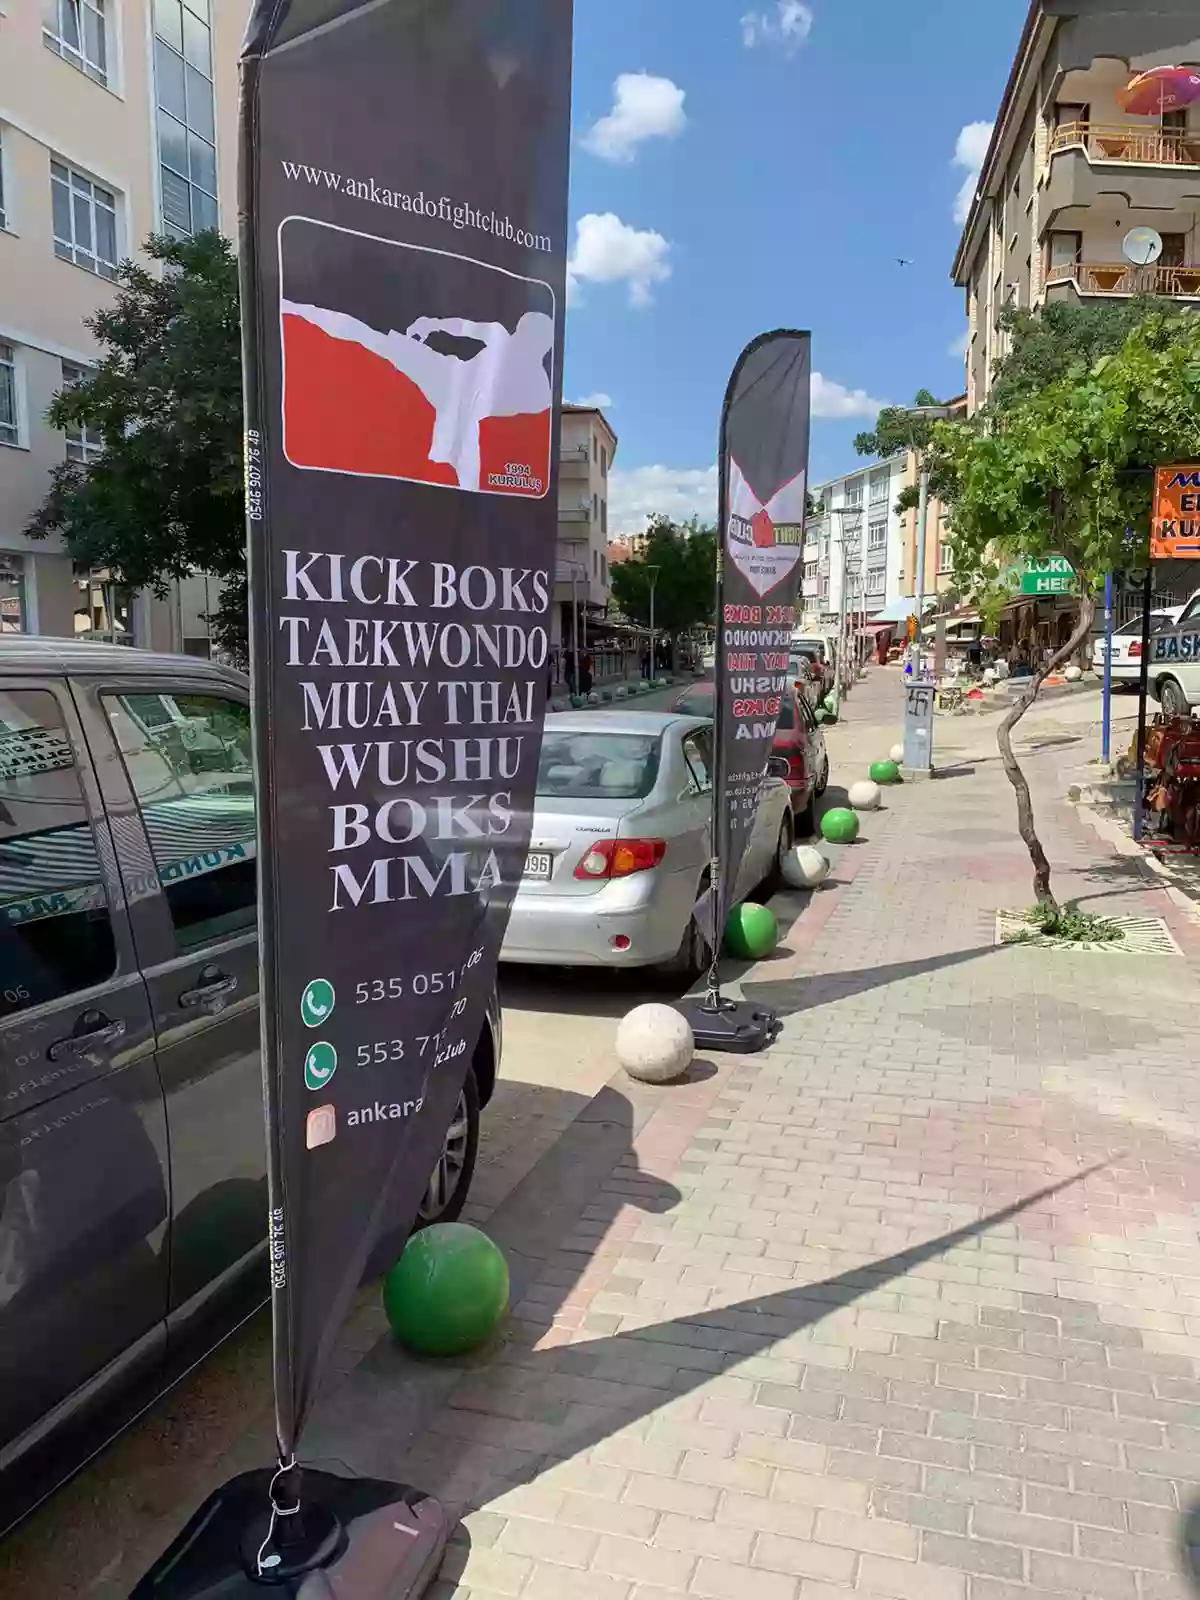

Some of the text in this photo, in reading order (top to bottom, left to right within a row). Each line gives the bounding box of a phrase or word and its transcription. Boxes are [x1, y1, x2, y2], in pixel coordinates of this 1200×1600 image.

[281, 160, 552, 252] www.ankaradofightclub.com
[249, 465, 261, 487] 907
[488, 475, 542, 492] KURULUŞ
[504, 463, 531, 476] 1994
[250, 490, 262, 520] 0546
[1180, 494, 1200, 511] E
[281, 550, 549, 614] KICK BOKS
[279, 616, 549, 669] TAEKWONDO
[299, 681, 535, 730] MUAY THAI
[316, 736, 525, 791] WUSHU
[328, 791, 514, 852] BOKS
[328, 848, 503, 913] MMA
[355, 977, 403, 1005] 535
[412, 969, 456, 995] 051
[356, 1039, 405, 1067] 553
[347, 1039, 466, 1126] ankara club
